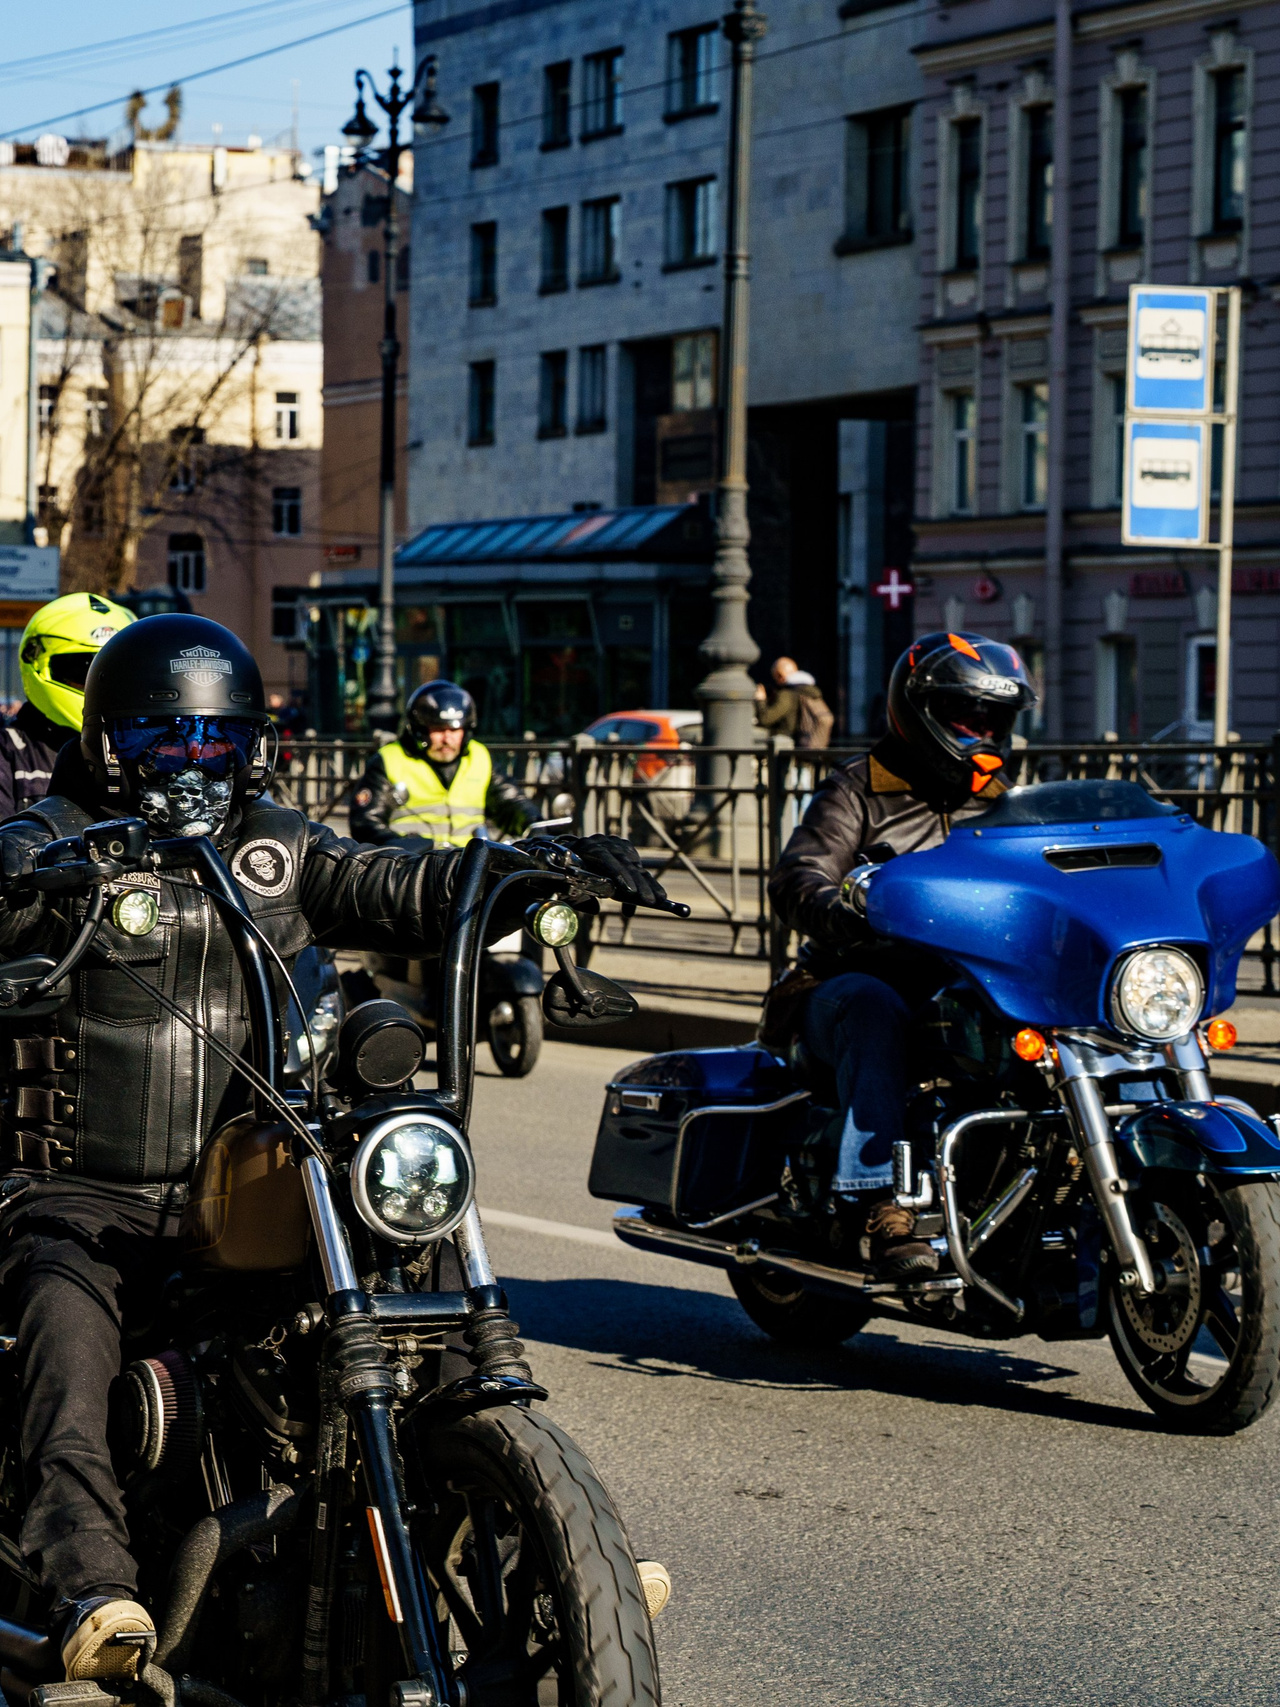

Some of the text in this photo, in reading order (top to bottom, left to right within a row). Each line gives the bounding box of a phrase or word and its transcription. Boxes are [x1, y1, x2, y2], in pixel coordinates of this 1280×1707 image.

[186, 648, 216, 658] MOTOR
[173, 660, 230, 671] HARLEY-DAVIDSON
[189, 671, 219, 685] CYCLES
[119, 871, 159, 886] ERSBURG
[245, 879, 257, 890] THE
